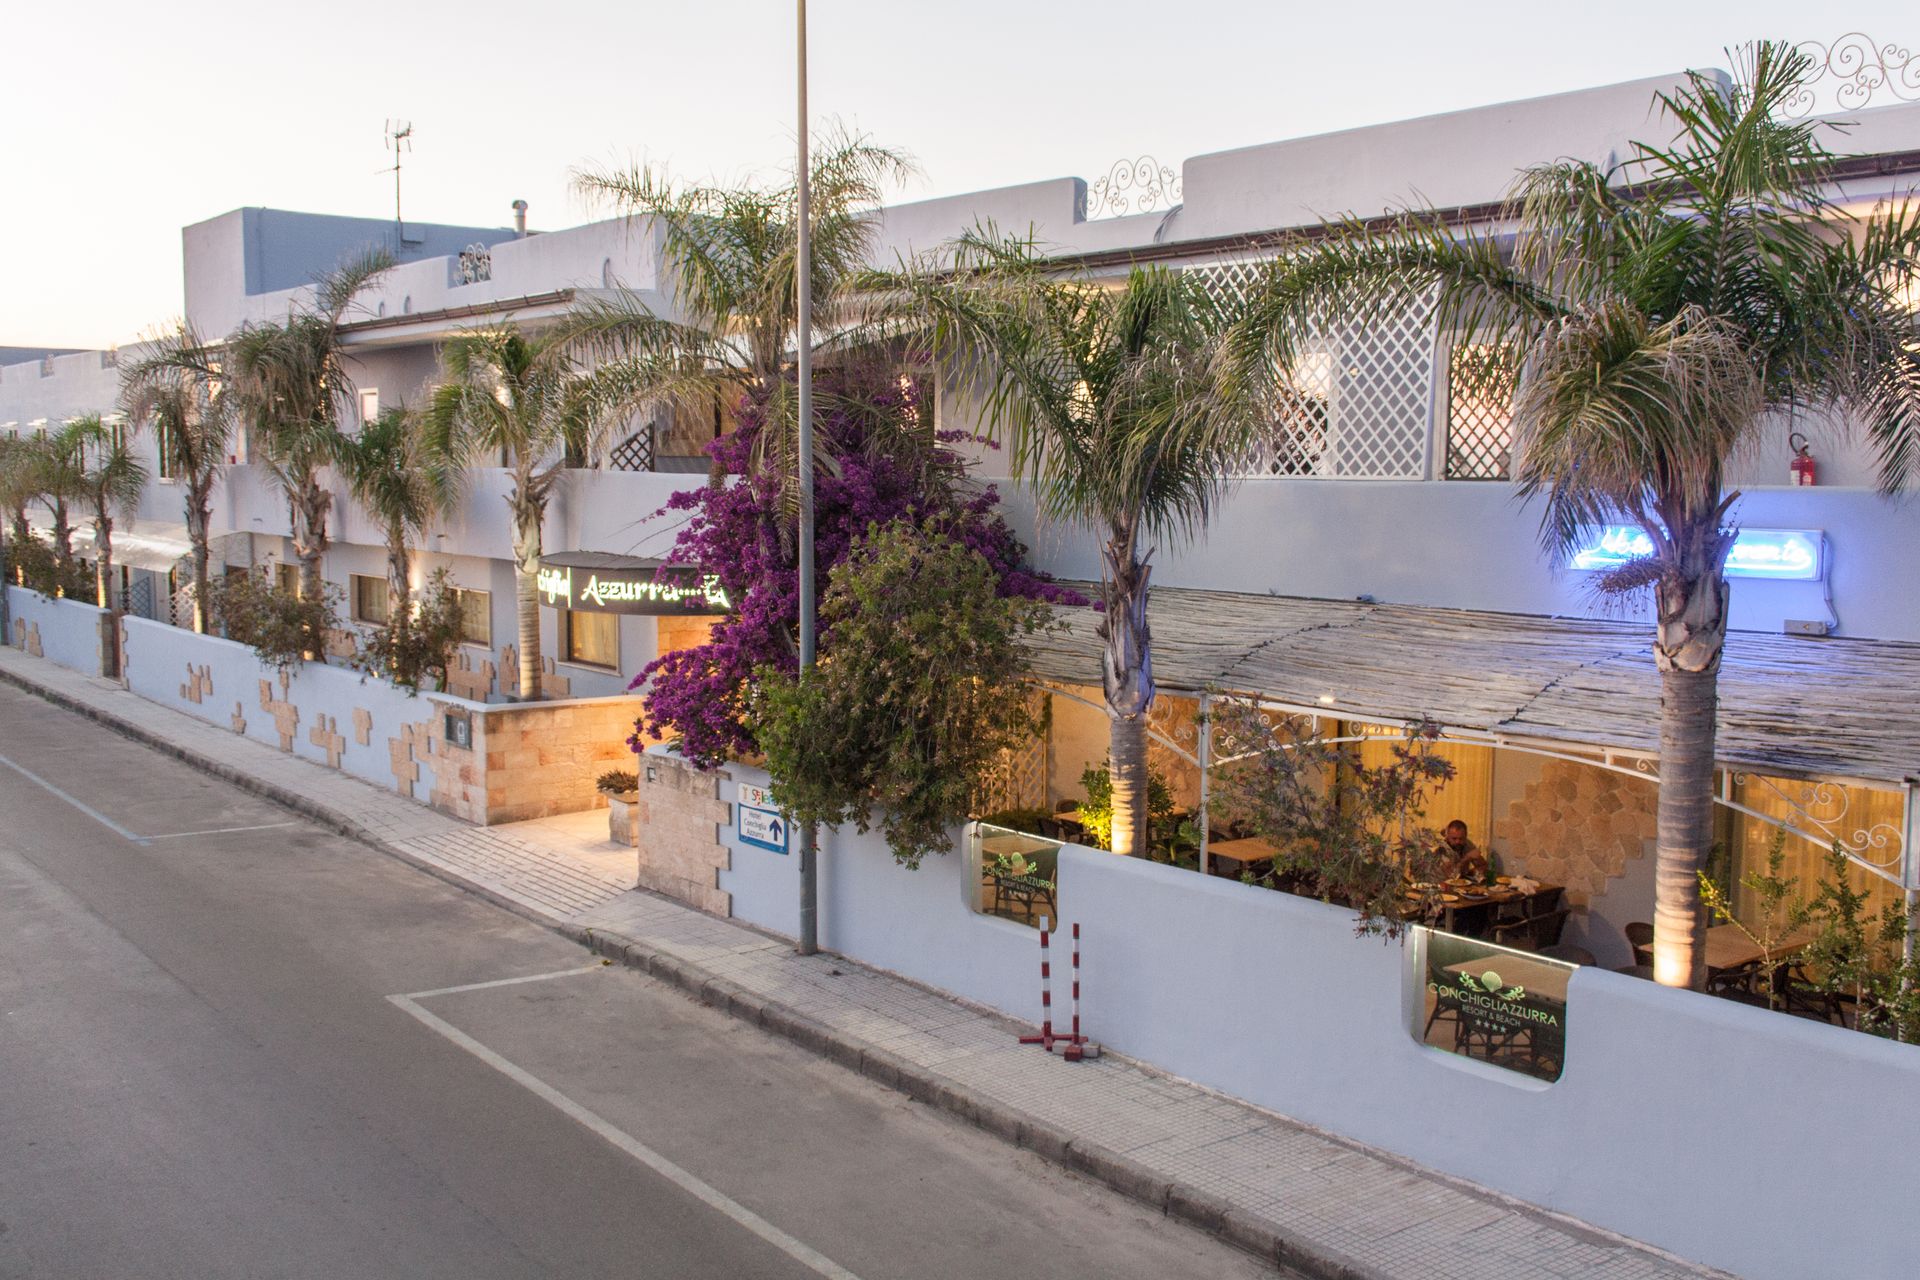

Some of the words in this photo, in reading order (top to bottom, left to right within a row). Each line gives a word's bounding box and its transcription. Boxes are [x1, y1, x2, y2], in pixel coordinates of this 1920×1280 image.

[581, 575, 680, 606] Azzurra
[1428, 982, 1558, 1027] CONCHIGLIAZZURRA
[1462, 1005, 1487, 1017] RESORT
[1489, 1012, 1494, 1020] &
[1496, 1013, 1521, 1027] BEACH
